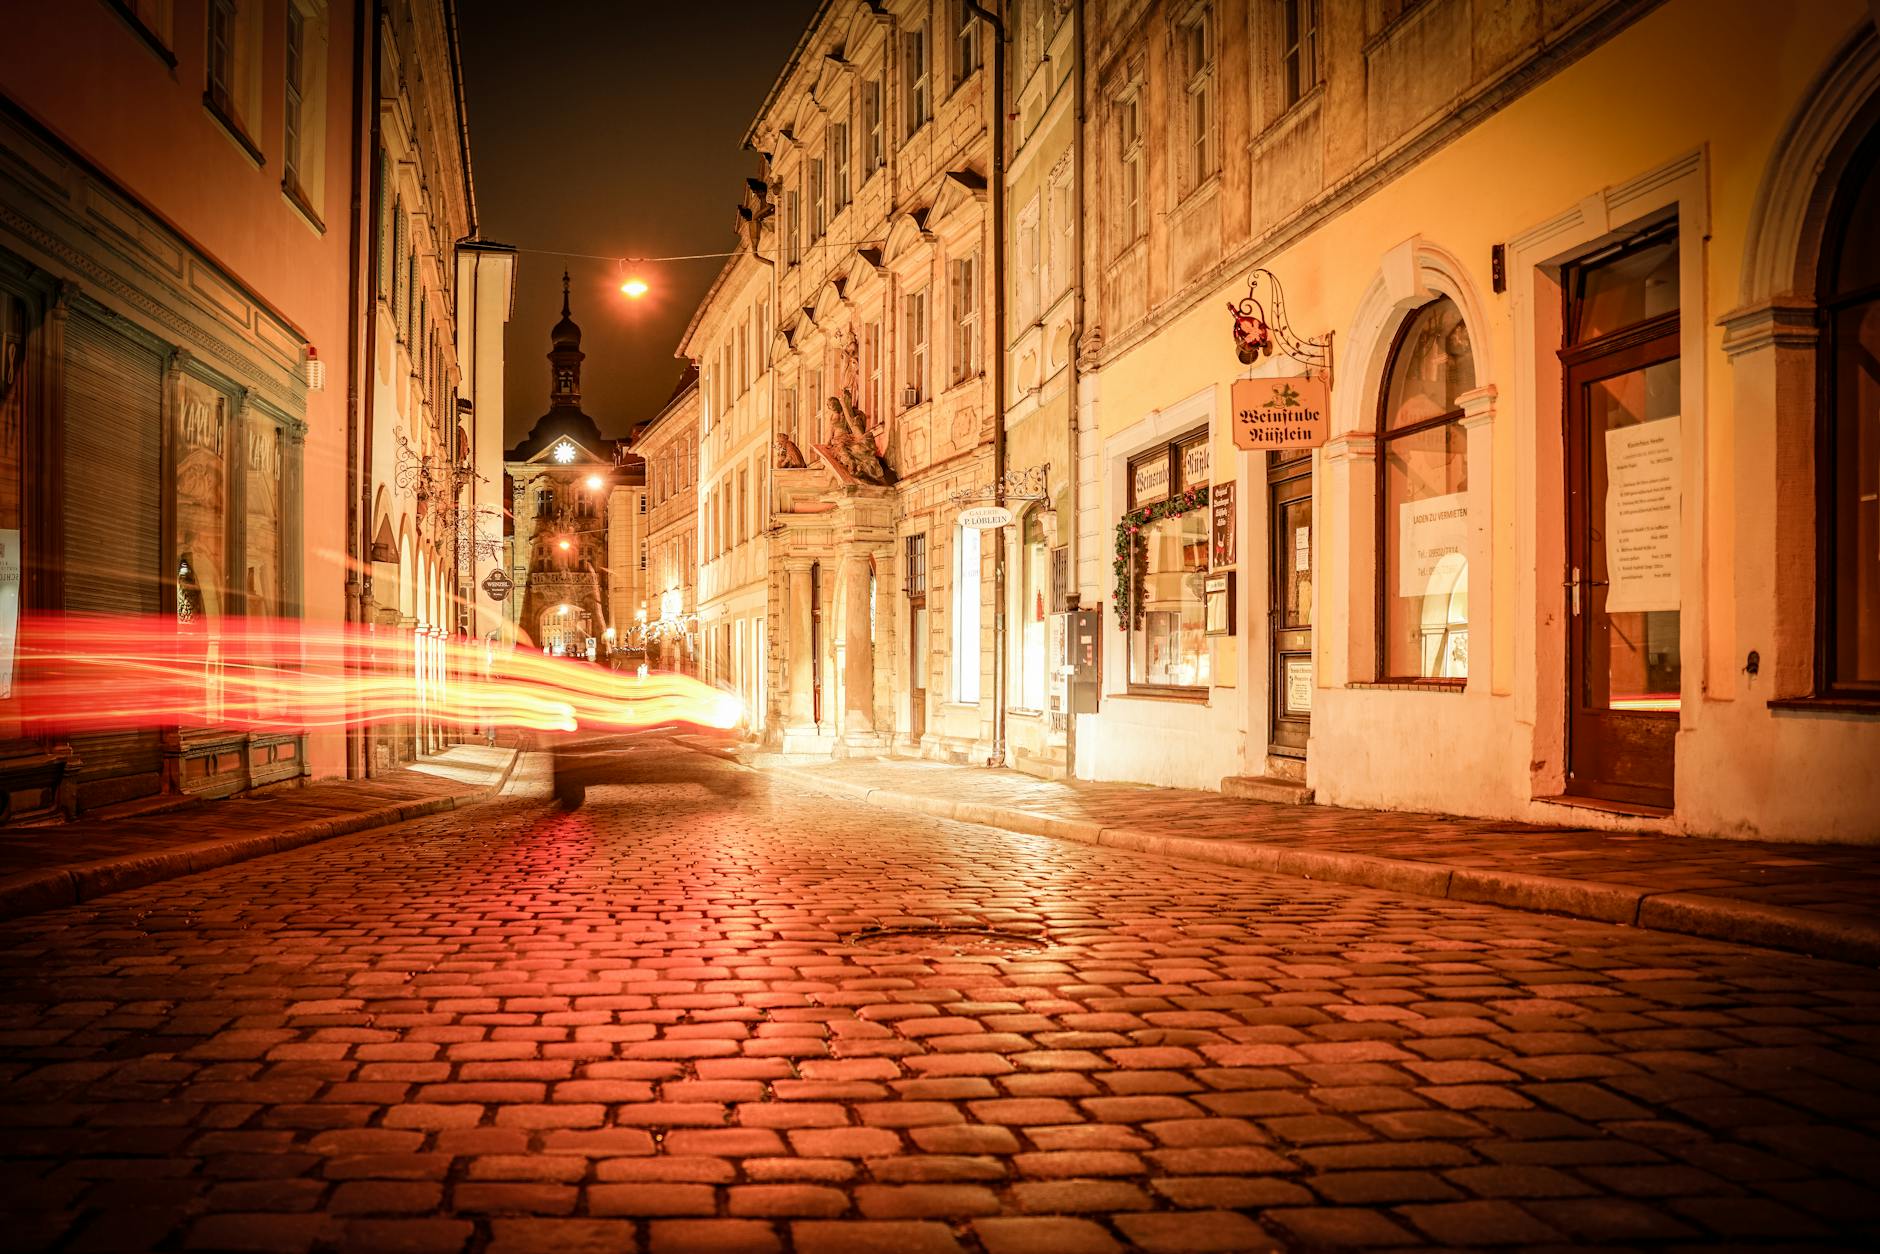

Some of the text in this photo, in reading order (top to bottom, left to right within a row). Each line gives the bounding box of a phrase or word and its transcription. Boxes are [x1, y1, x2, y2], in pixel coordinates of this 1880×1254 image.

[1413, 508, 1468, 525] LADEN ZU VERMIETEN
